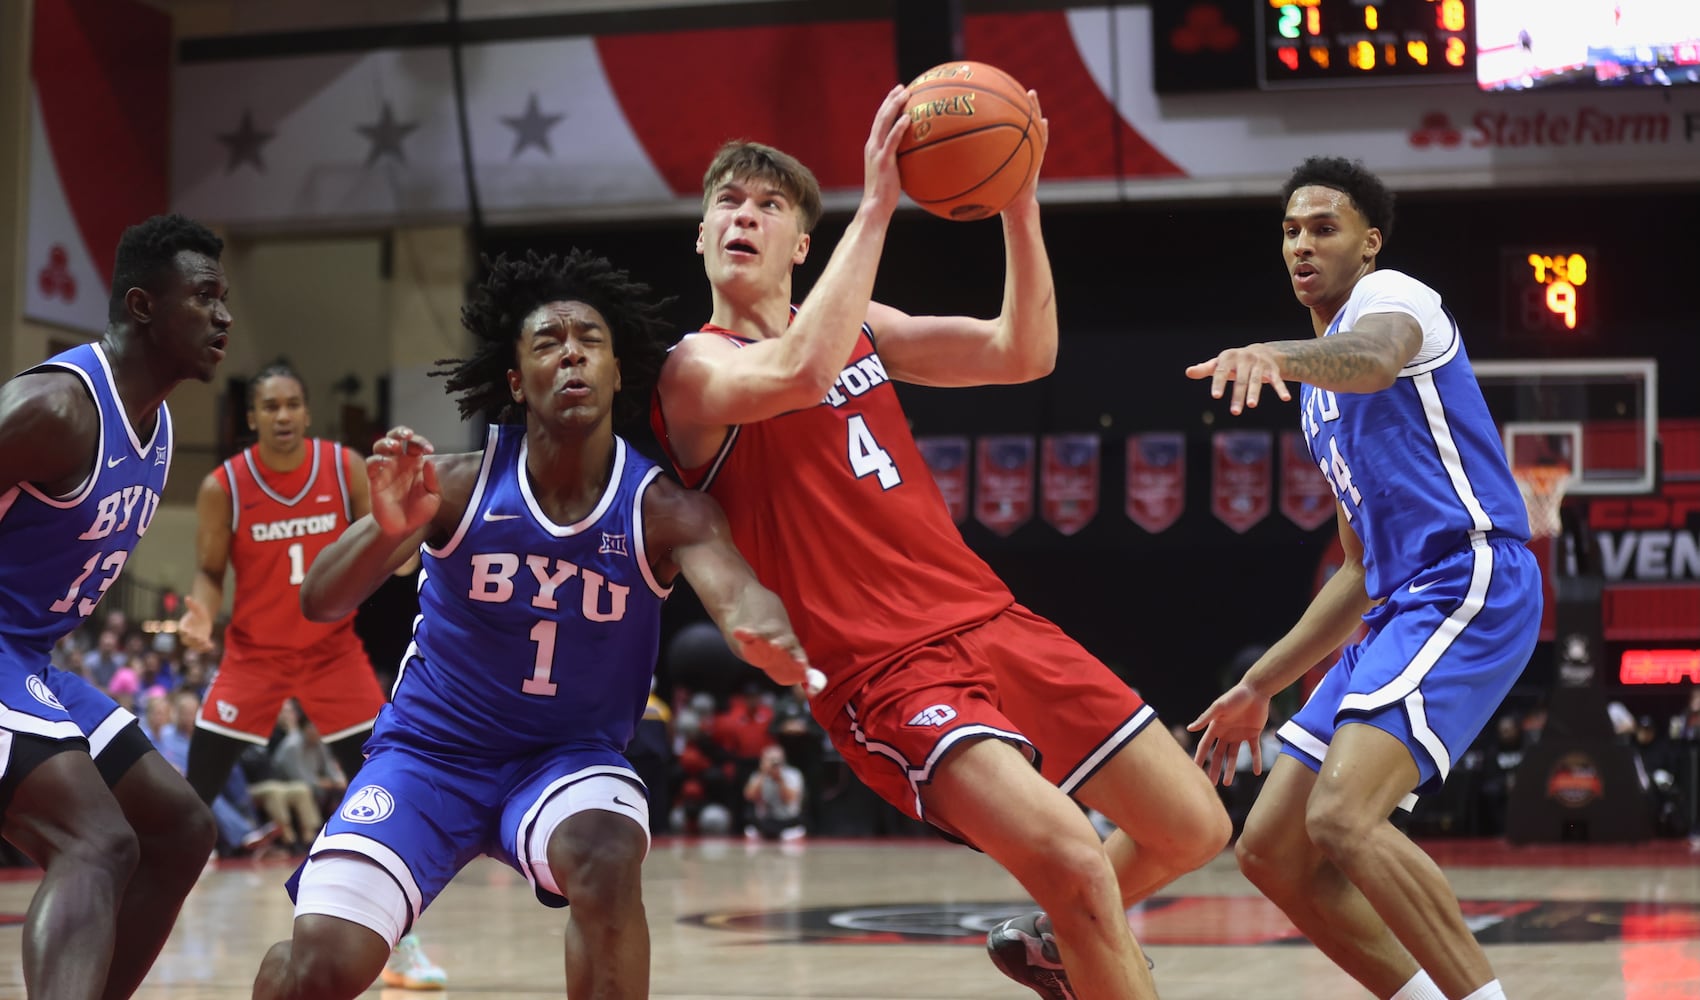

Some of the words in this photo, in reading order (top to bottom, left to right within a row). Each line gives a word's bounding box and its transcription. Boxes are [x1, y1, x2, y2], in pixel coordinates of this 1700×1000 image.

[905, 92, 975, 124] SPALD
[1546, 281, 1577, 329] 9
[847, 413, 903, 491] 4
[77, 485, 160, 541] BYU
[251, 512, 337, 542] DAYTON
[288, 542, 306, 585] 1
[1564, 530, 1700, 581] VEN
[49, 550, 128, 617] 13
[468, 552, 631, 623] BYU
[521, 619, 558, 697] 1
